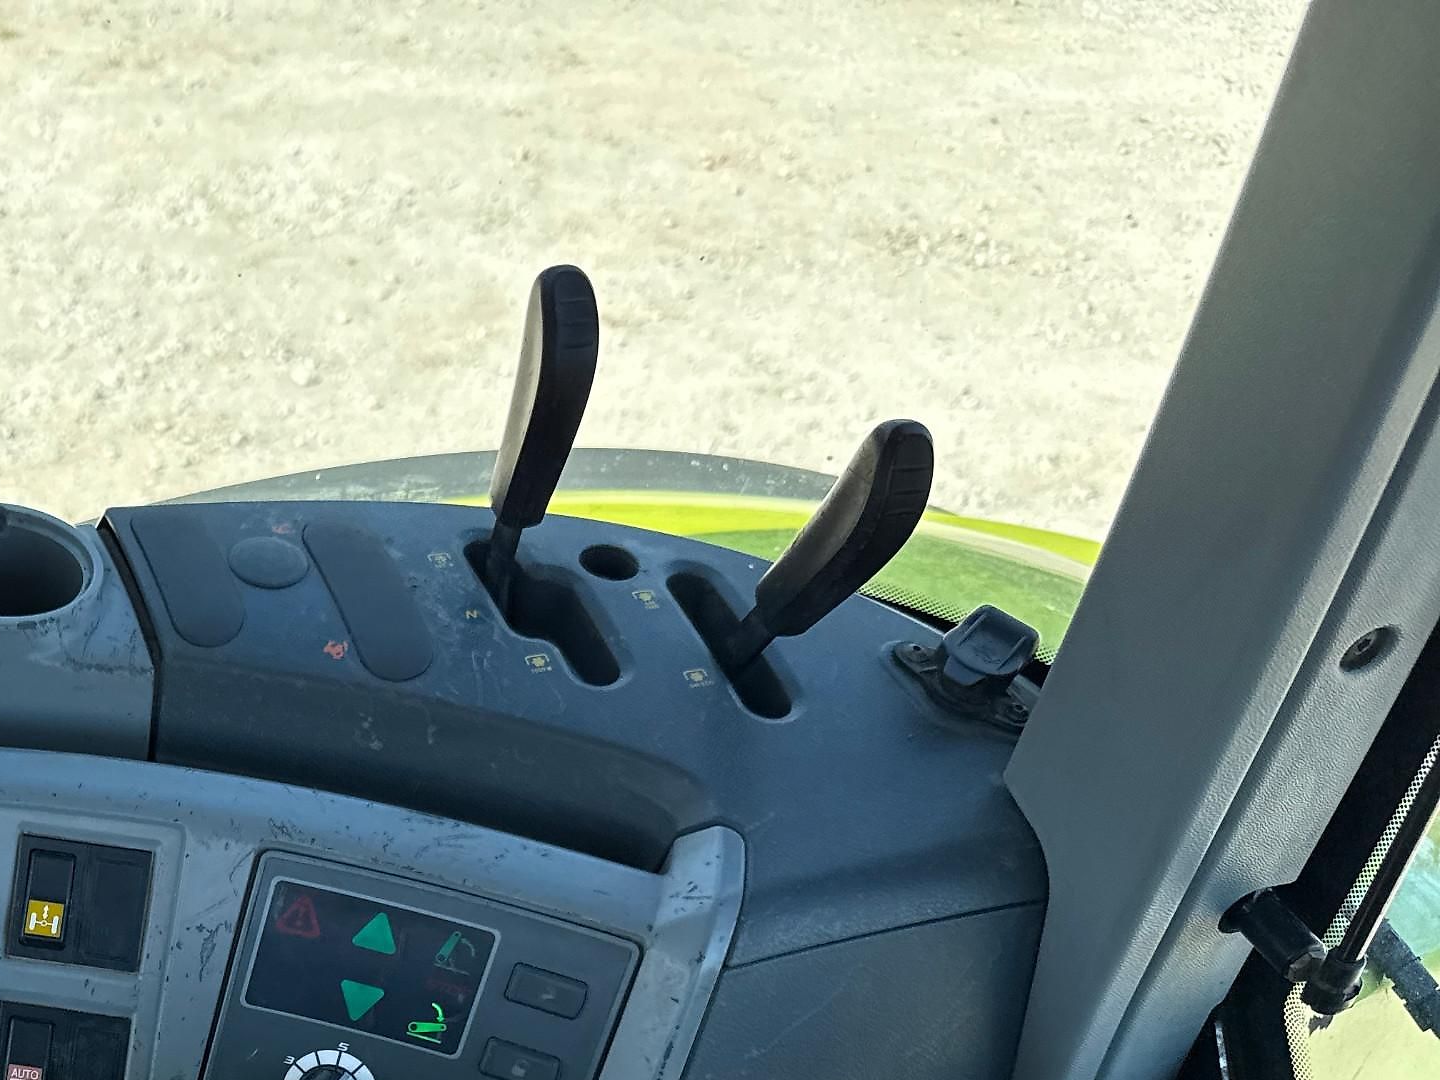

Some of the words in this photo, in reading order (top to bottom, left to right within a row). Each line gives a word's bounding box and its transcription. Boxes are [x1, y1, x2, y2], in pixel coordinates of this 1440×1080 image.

[337, 1042, 350, 1052] 5
[283, 1055, 295, 1065] 3
[11, 1067, 39, 1080] AUTO
